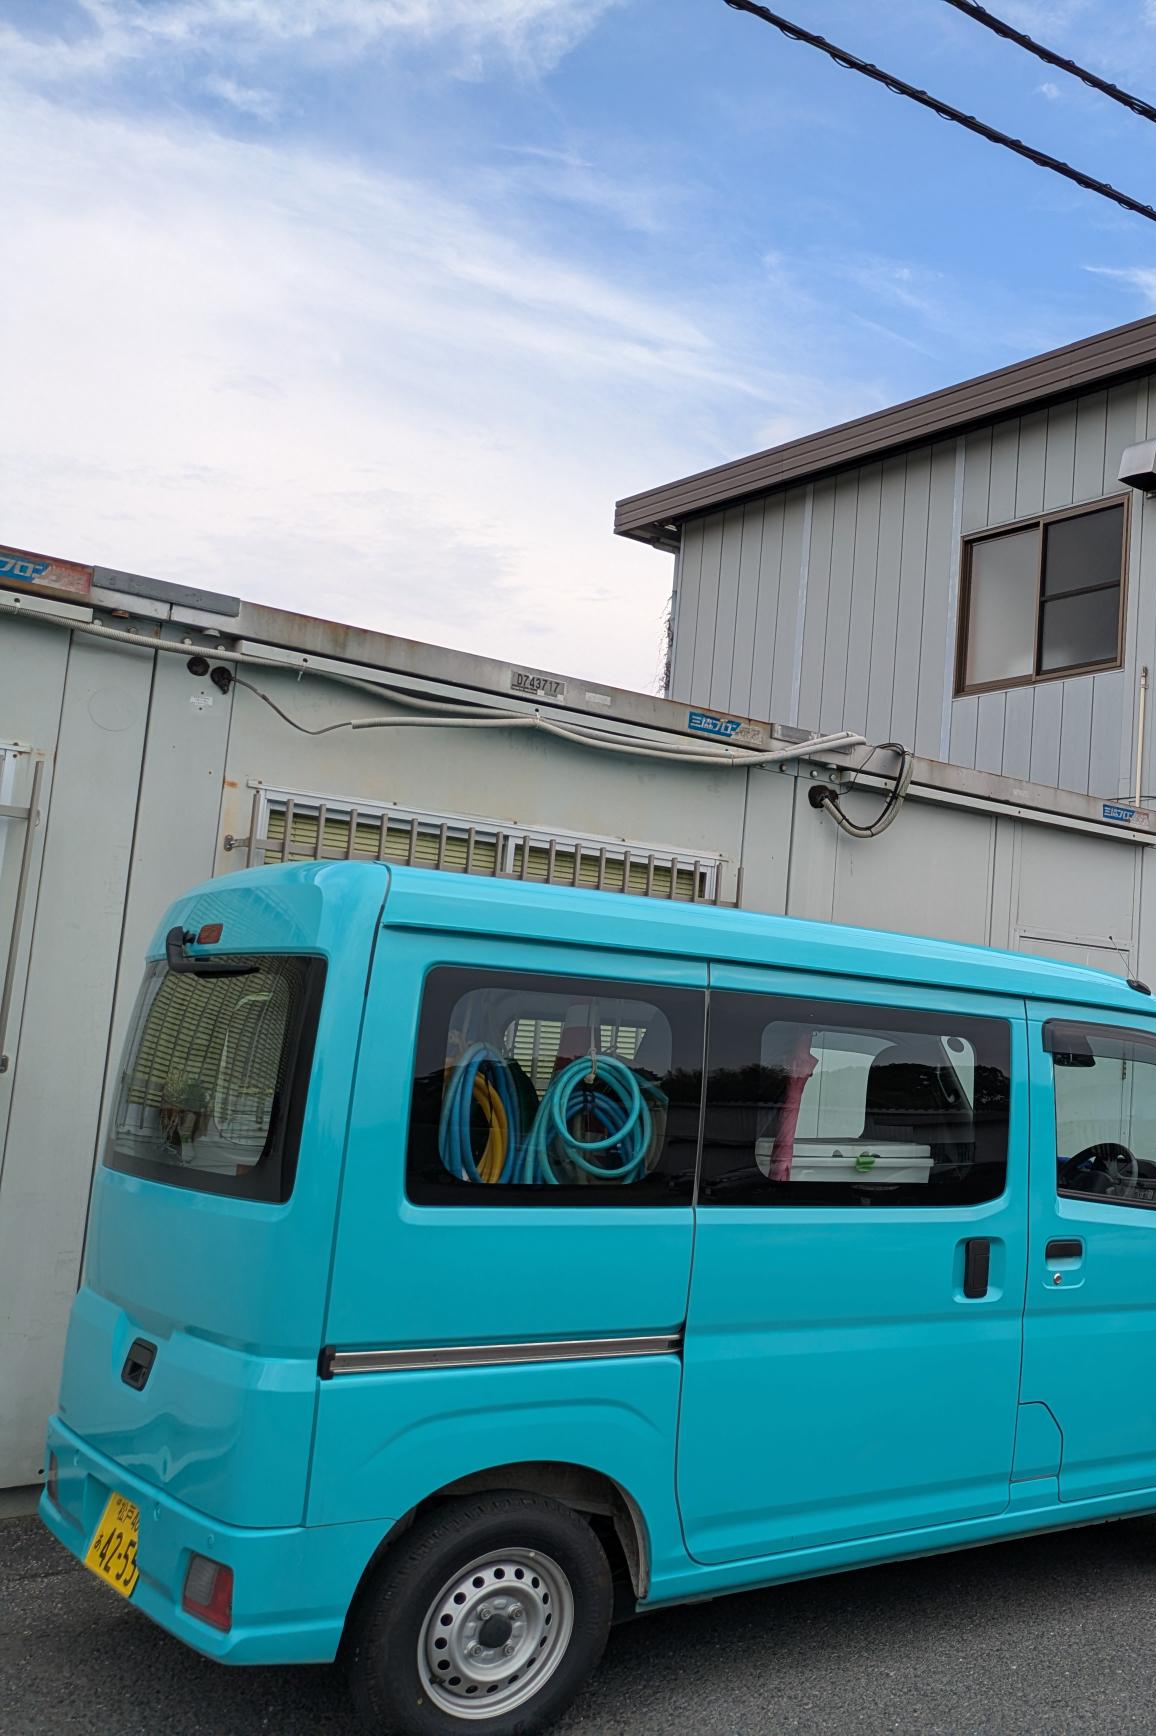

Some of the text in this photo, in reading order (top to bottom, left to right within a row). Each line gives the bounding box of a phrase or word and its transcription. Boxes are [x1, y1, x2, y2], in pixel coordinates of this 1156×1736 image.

[517, 672, 561, 694] D743717
[118, 1502, 136, 1523] 松戸
[99, 1527, 138, 1587] 42-55
